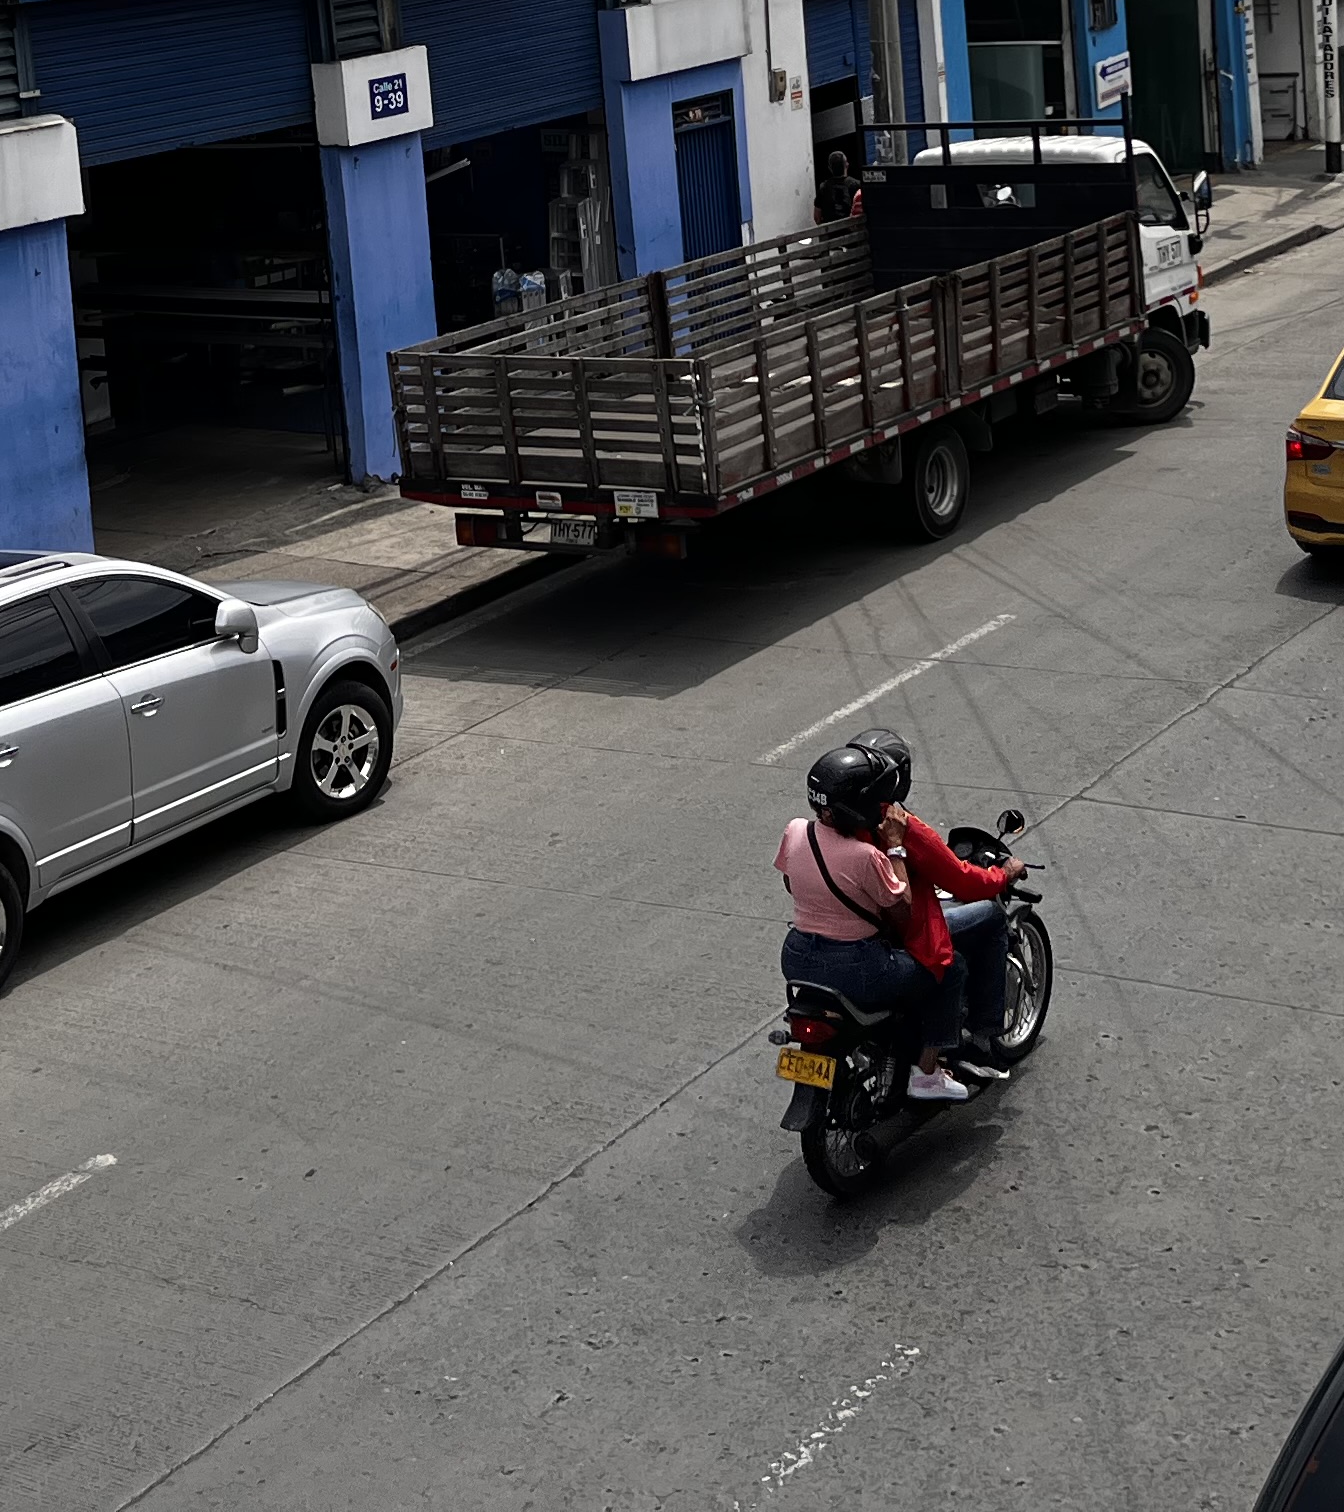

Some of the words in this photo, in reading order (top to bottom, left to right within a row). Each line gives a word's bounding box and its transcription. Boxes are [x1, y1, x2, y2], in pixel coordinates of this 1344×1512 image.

[373, 82, 393, 93] Calle
[394, 78, 403, 90] 21
[374, 91, 404, 112] 9-39
